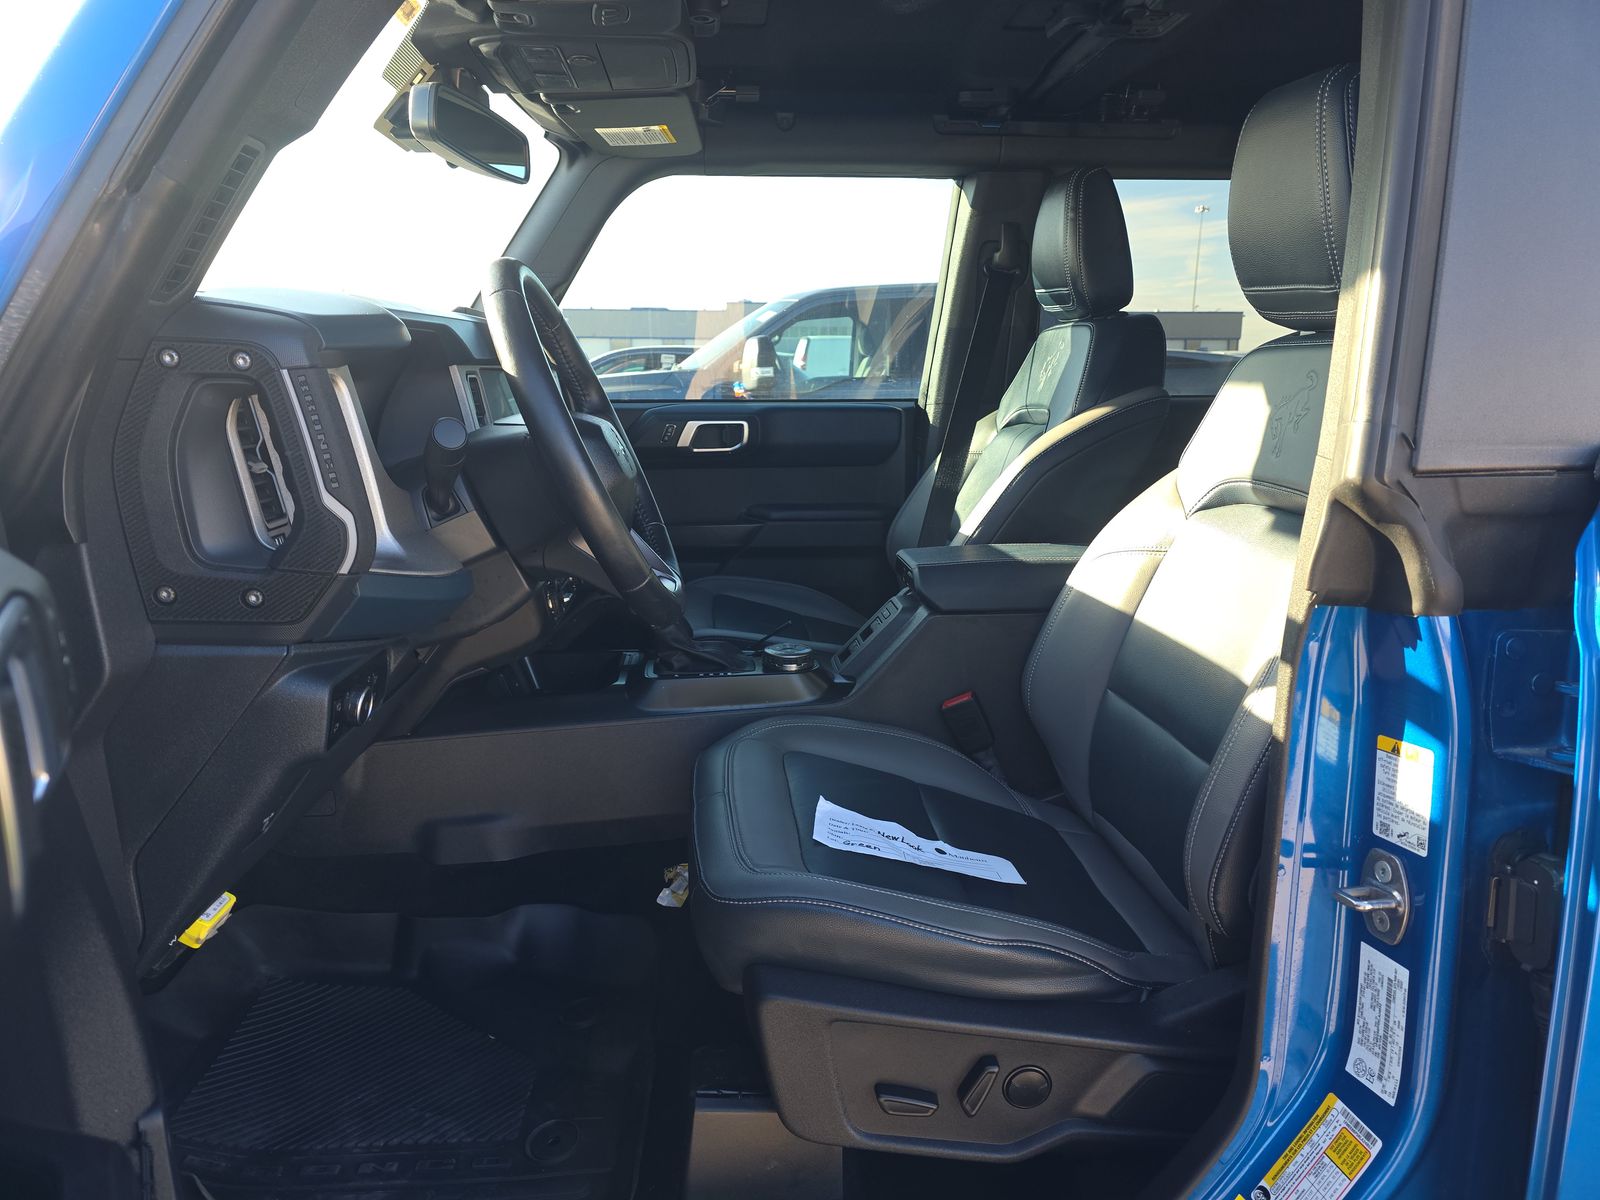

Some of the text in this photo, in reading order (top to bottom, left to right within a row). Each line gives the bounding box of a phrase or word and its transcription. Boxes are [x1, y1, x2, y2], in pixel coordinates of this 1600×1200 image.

[842, 839, 881, 852] Green
[878, 830, 925, 853] New Look
